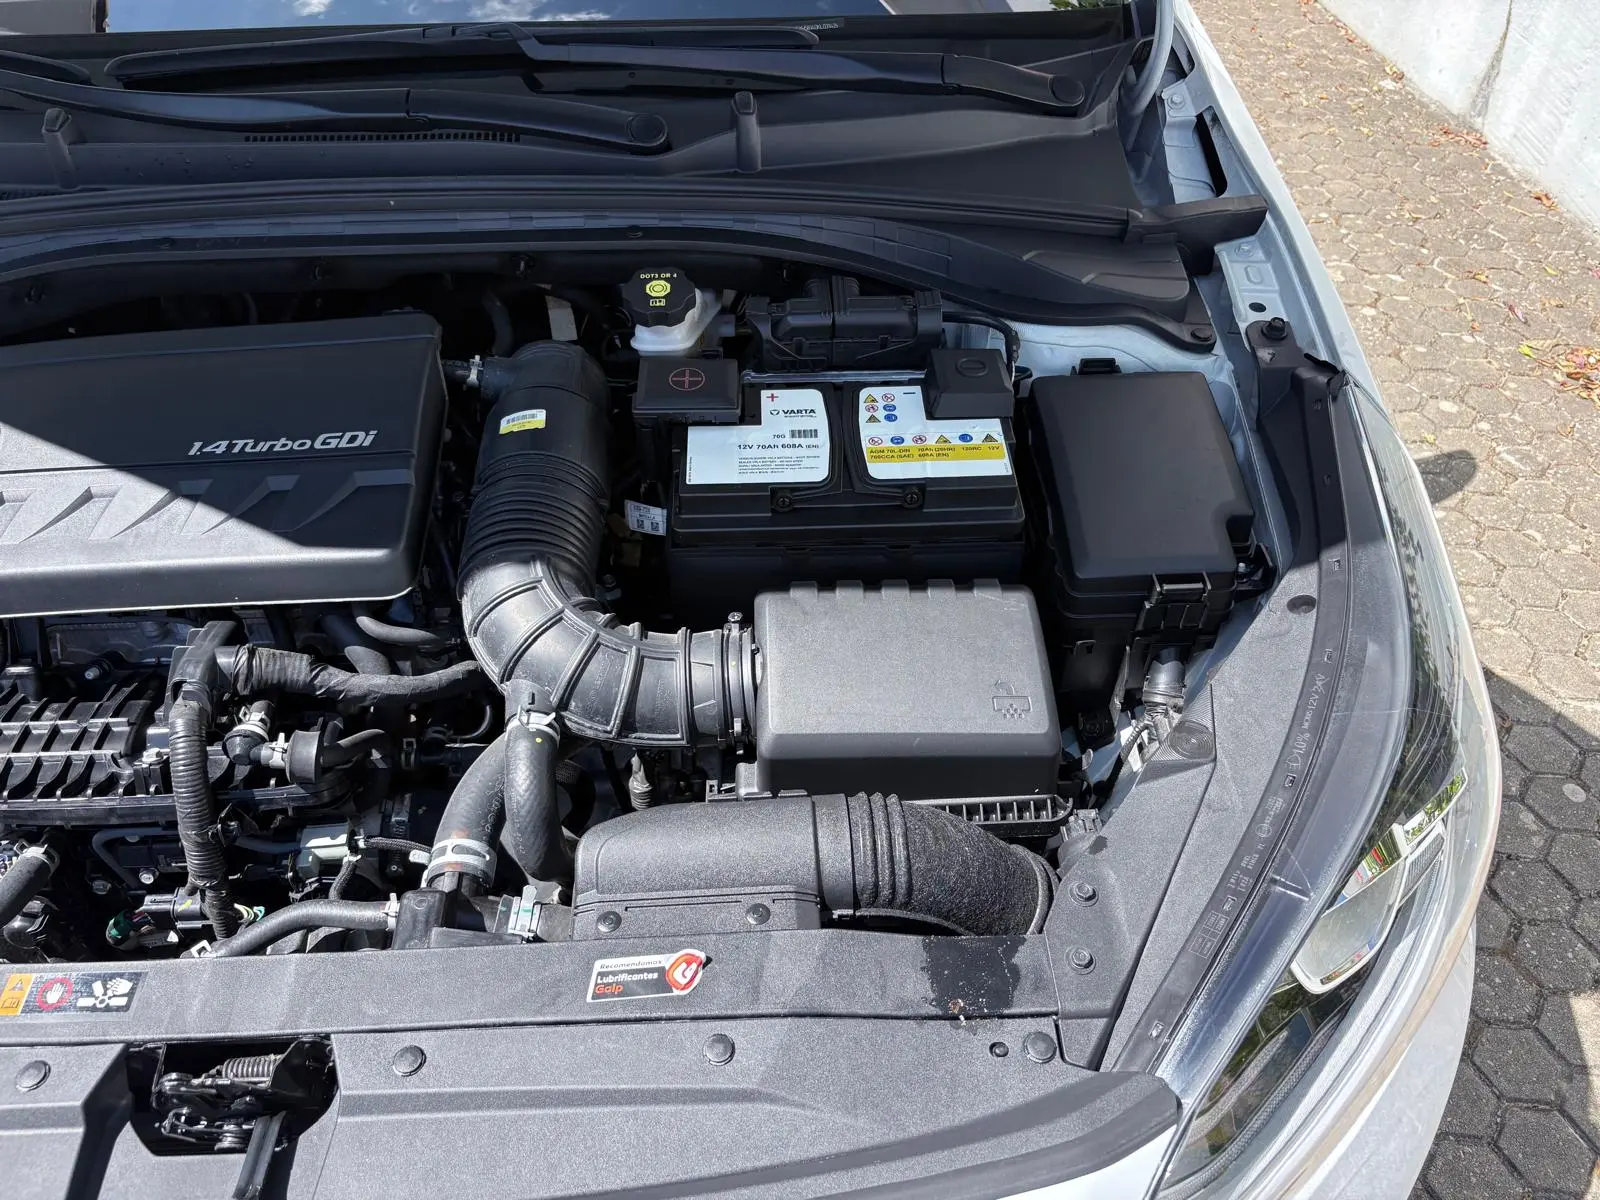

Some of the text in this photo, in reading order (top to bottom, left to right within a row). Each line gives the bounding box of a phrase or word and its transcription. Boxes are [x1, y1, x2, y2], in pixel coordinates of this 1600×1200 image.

[187, 430, 378, 456] 1.4 Turbo GDi
[597, 972, 659, 984] Lubrificantes
[595, 983, 624, 995] Galp
